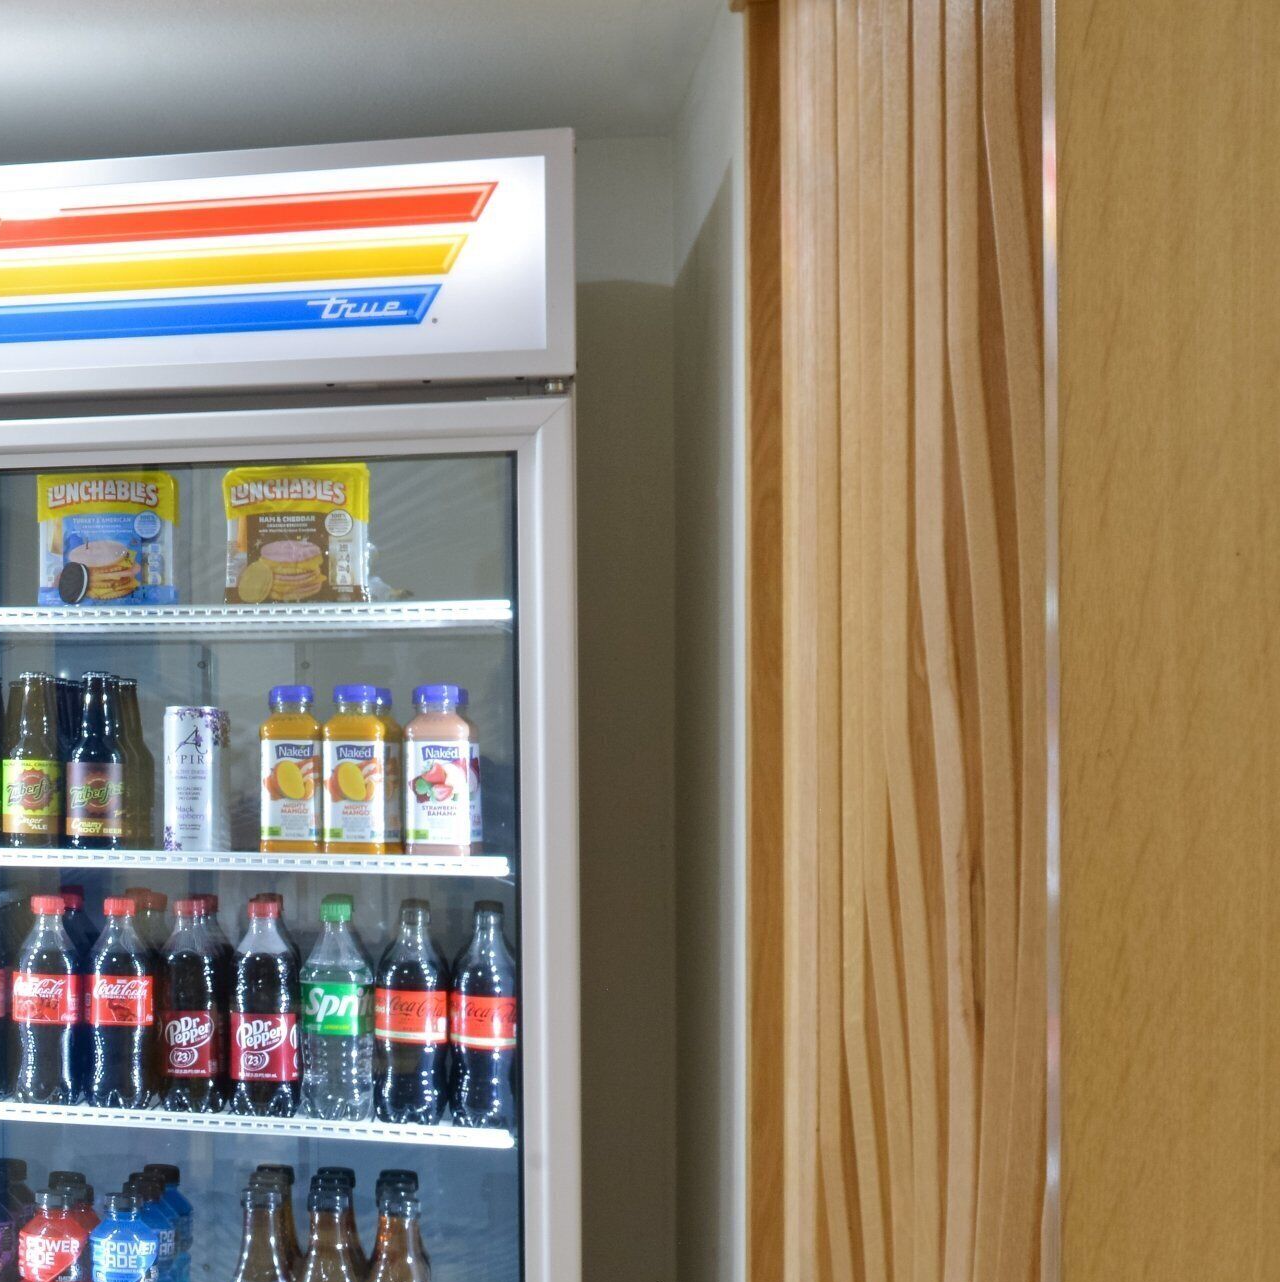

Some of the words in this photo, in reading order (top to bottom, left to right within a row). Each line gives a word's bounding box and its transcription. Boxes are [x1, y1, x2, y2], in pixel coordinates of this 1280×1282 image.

[307, 298, 408, 319] true
[47, 480, 159, 508] LUNCHABLES
[230, 478, 347, 507] LUNCHABLES
[71, 819, 103, 828] Creamy
[180, 1017, 200, 1033] Dr
[252, 1020, 272, 1035] Dr
[169, 1021, 210, 1046] Pepper
[241, 1023, 282, 1049] Pepper
[176, 1052, 188, 1061] 23
[248, 1056, 259, 1064] 23
[26, 1237, 80, 1253] POWER
[107, 1240, 156, 1256] POWER
[26, 1252, 55, 1266] ADE
[104, 1254, 138, 1268] ADE
